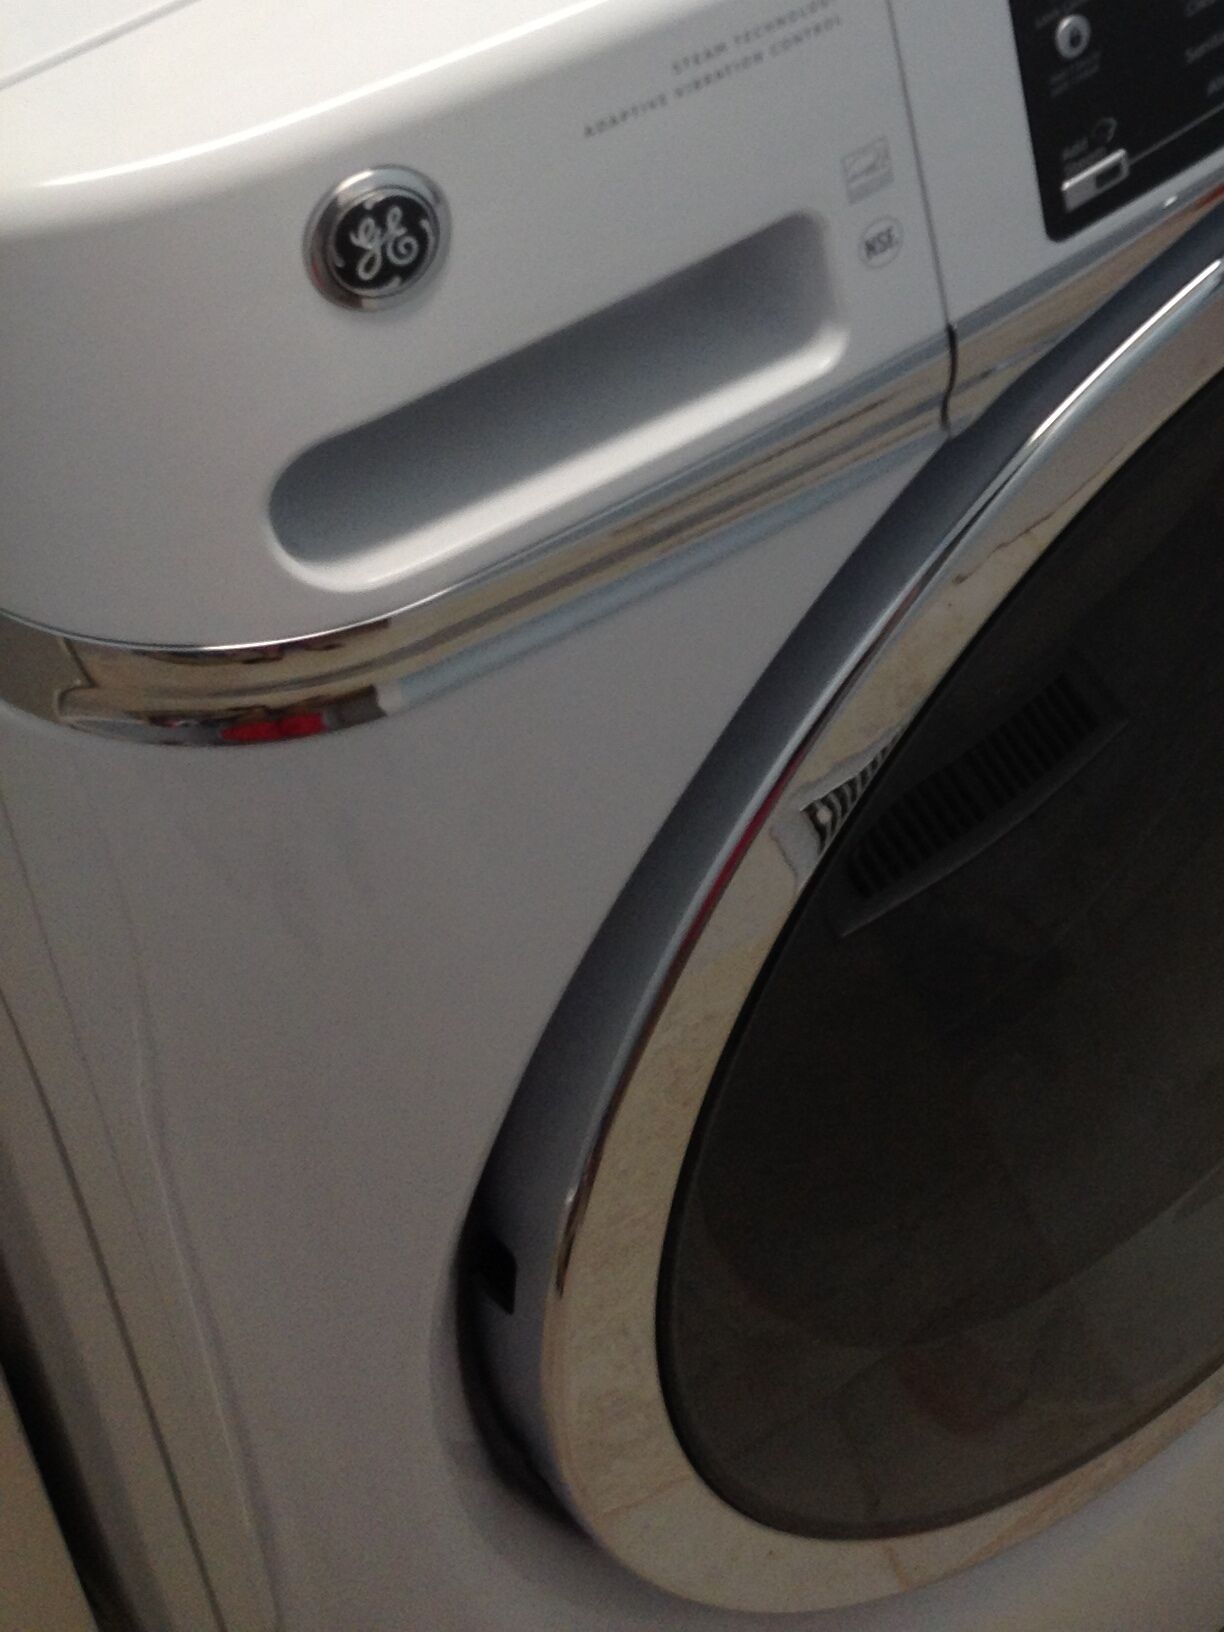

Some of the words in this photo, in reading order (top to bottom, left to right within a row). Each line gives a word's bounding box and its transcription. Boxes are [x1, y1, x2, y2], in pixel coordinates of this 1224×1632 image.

[583, 92, 668, 139] ADAPTIVE
[674, 51, 764, 100] VIBRATION
[769, 16, 842, 58] CONTROL
[672, 41, 728, 76] STEAM
